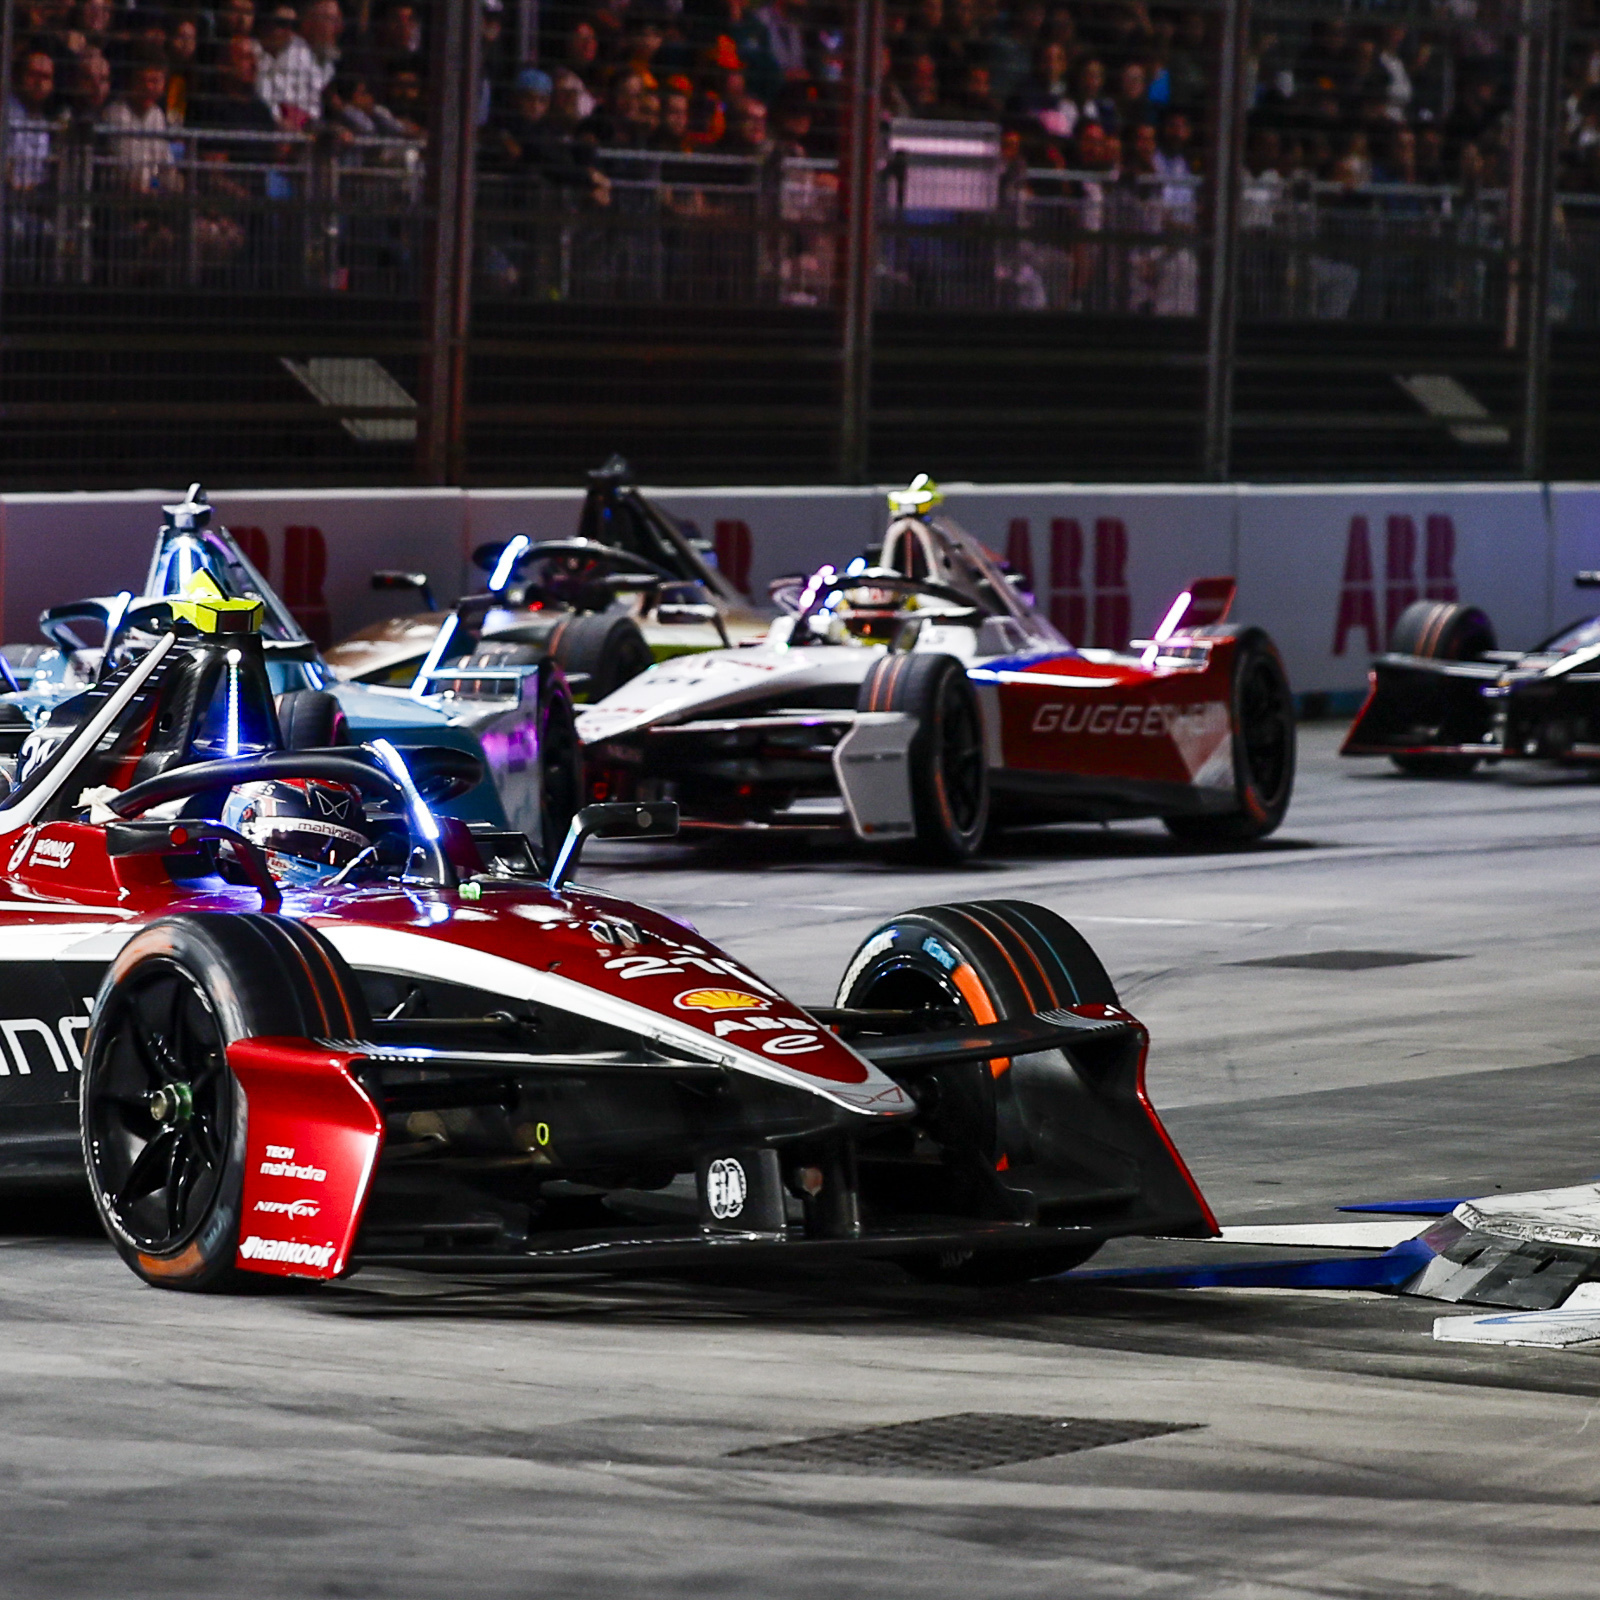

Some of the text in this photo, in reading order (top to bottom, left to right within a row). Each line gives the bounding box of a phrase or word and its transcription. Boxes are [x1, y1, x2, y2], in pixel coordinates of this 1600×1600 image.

[1334, 514, 1458, 655] ABB
[713, 1016, 819, 1037] ABB
[265, 1145, 295, 1159] TECH
[260, 1161, 328, 1182] mahindra
[708, 1172, 744, 1206] FIA
